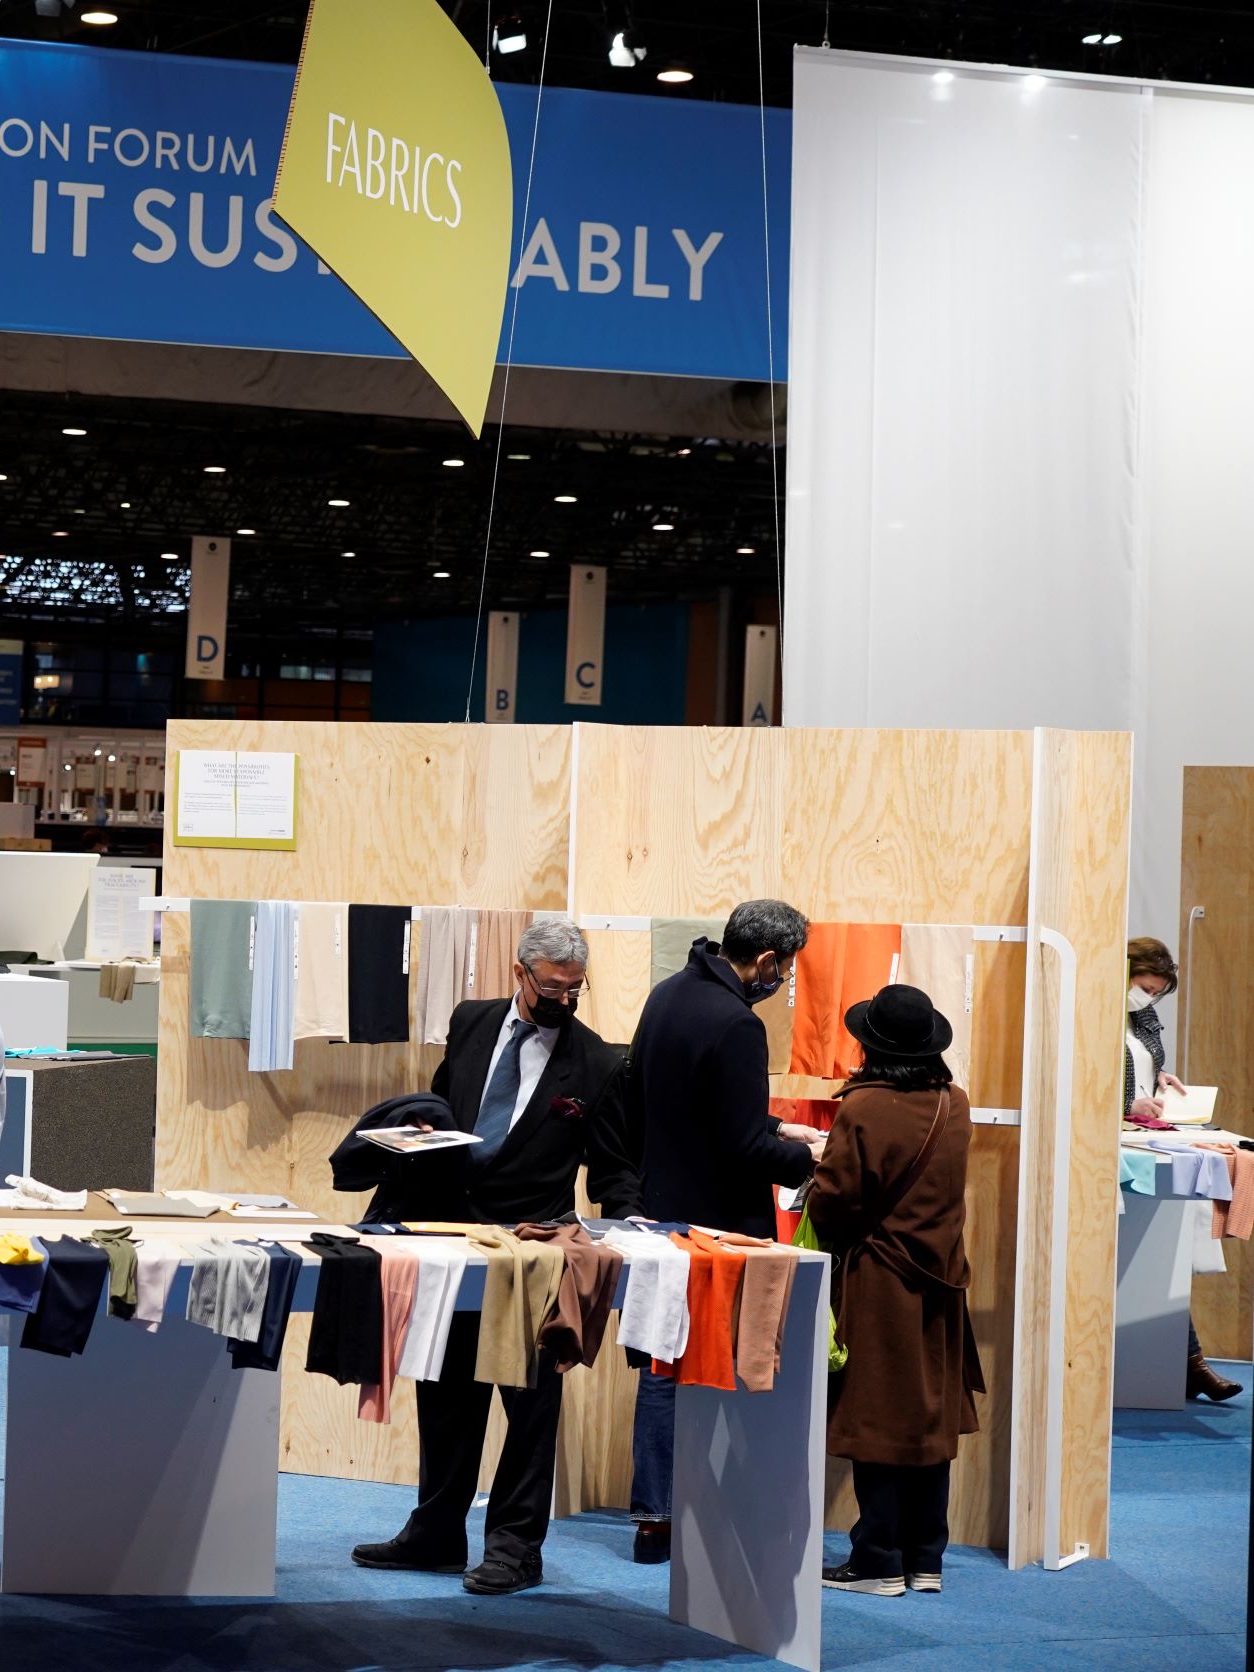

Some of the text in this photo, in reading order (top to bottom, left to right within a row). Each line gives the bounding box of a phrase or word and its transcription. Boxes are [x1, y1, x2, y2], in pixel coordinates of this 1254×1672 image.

[88, 124, 257, 177] FORUM
[326, 111, 462, 229] FABRICS
[31, 178, 105, 257] IT
[132, 187, 724, 302] SUSABLY
[196, 634, 219, 662] D
[575, 661, 596, 689] C
[496, 688, 509, 711] B
[750, 701, 768, 723] A
